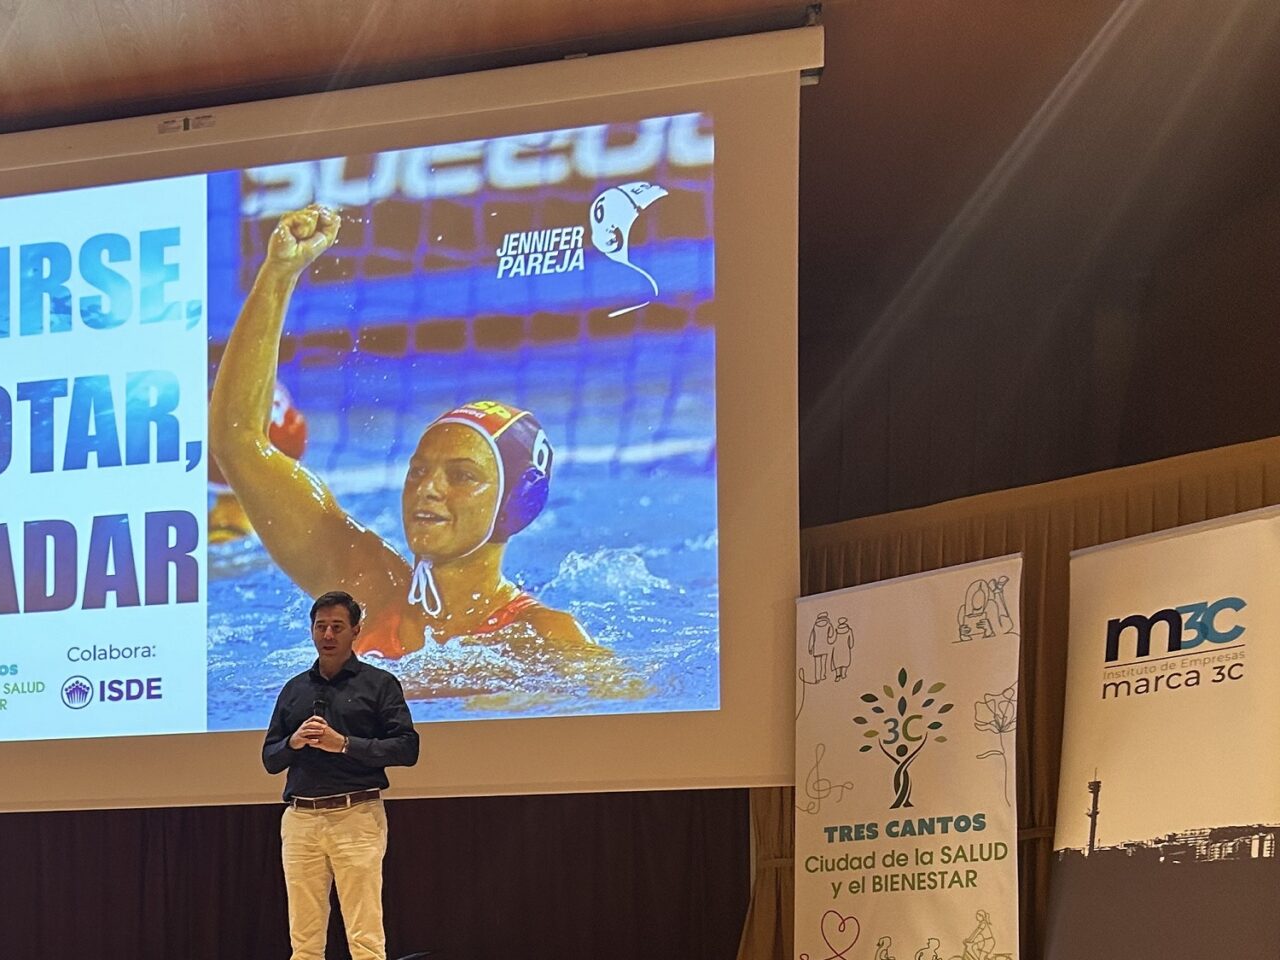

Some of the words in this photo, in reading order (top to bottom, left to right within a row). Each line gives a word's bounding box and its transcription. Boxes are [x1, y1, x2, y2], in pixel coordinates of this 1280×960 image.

[594, 196, 606, 224] 6
[496, 226, 585, 257] JENNIFER
[496, 248, 585, 279] PAREJA
[532, 429, 550, 475] 6
[67, 644, 157, 662] Colabora:
[1103, 665, 1157, 680] Instituto
[1160, 661, 1177, 672] de
[1181, 650, 1246, 669] Empresas
[3, 681, 46, 695] SALUD
[99, 678, 163, 702] ISDE
[1102, 669, 1200, 699] marca
[1211, 662, 1244, 683] 3C
[882, 713, 924, 745] 3C
[824, 822, 879, 843] TRES
[885, 813, 987, 838] CANTOS
[805, 851, 876, 873] Ciudad
[882, 849, 909, 868] de
[915, 848, 934, 866] la
[940, 842, 1008, 865] SALUD
[831, 880, 842, 899] y
[848, 876, 865, 894] el
[872, 869, 978, 893] BIENESTAR
